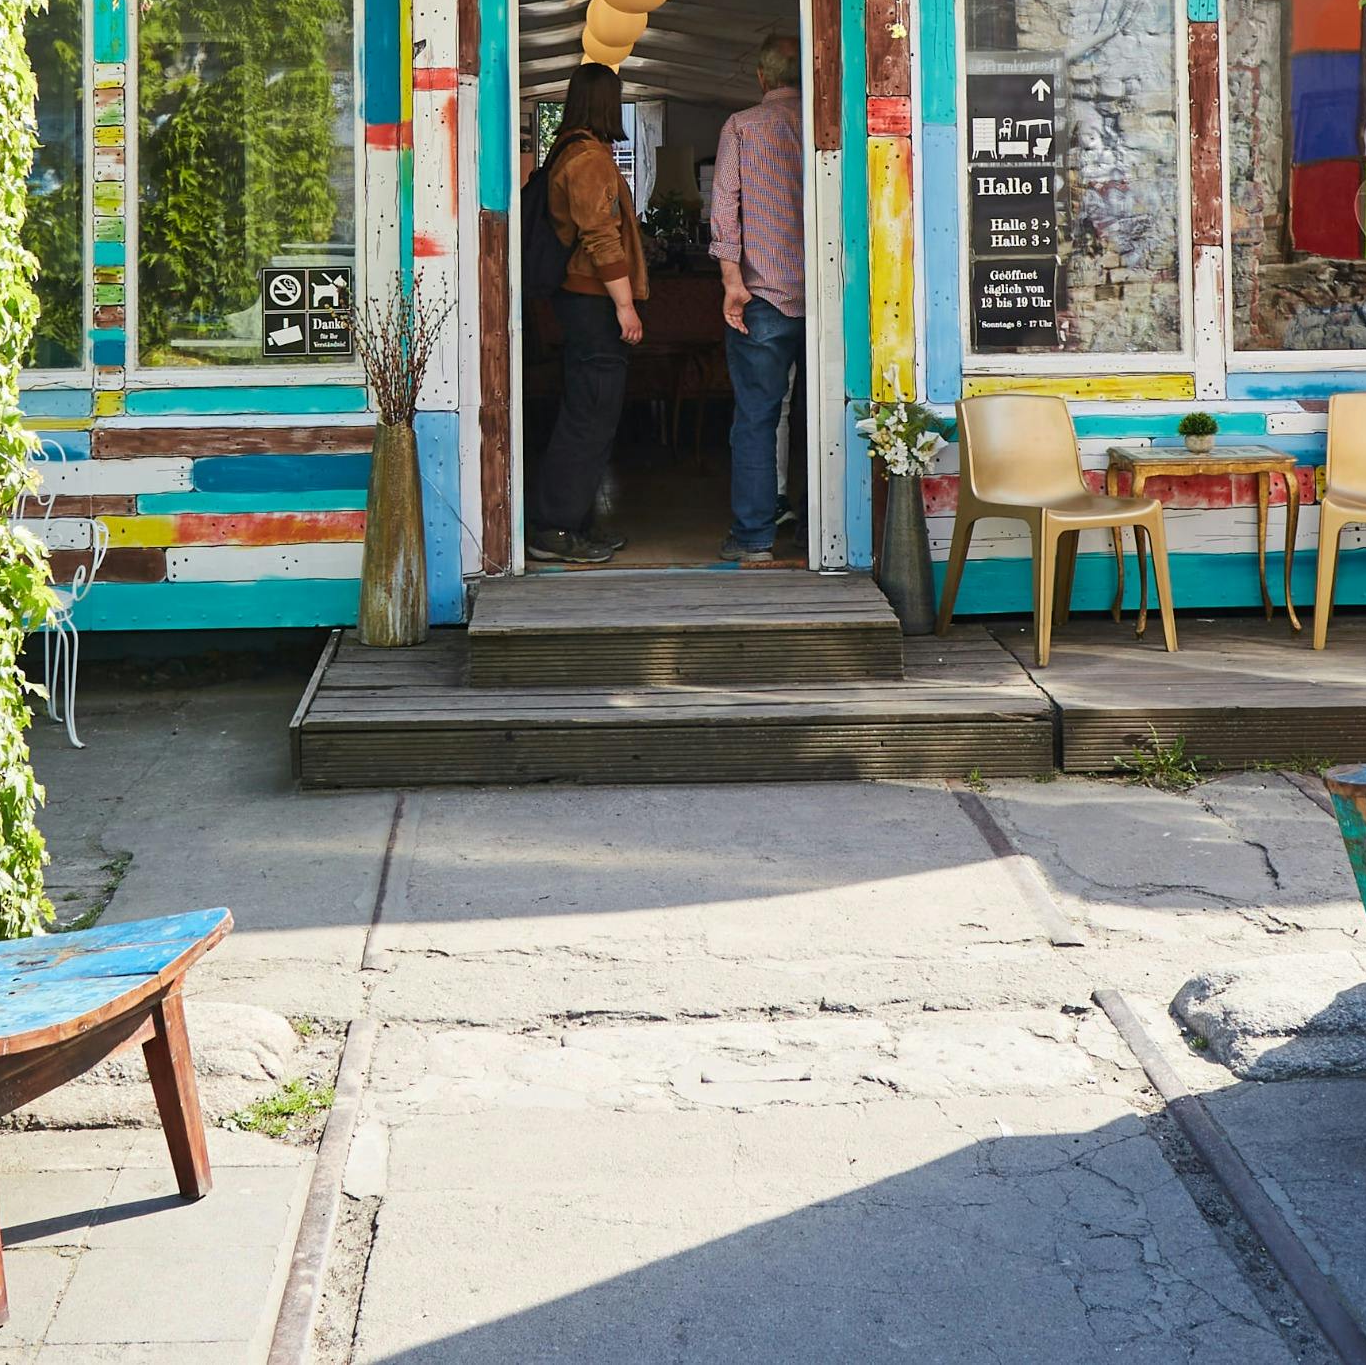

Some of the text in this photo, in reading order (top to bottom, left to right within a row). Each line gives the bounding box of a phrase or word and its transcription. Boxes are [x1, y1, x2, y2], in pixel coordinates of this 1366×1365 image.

[976, 176, 1050, 196] Halle 1
[990, 218, 1039, 232] Halle 2
[990, 234, 1040, 248] Halle 3
[989, 269, 1038, 281] Geöffnet
[983, 282, 1045, 297] täglich von
[980, 296, 1053, 308] 12 bis 19 Uhr
[981, 319, 1015, 330] Sonntags
[1016, 320, 1023, 328] 8
[1028, 319, 1038, 328] 17
[1038, 319, 1053, 328] Uhr
